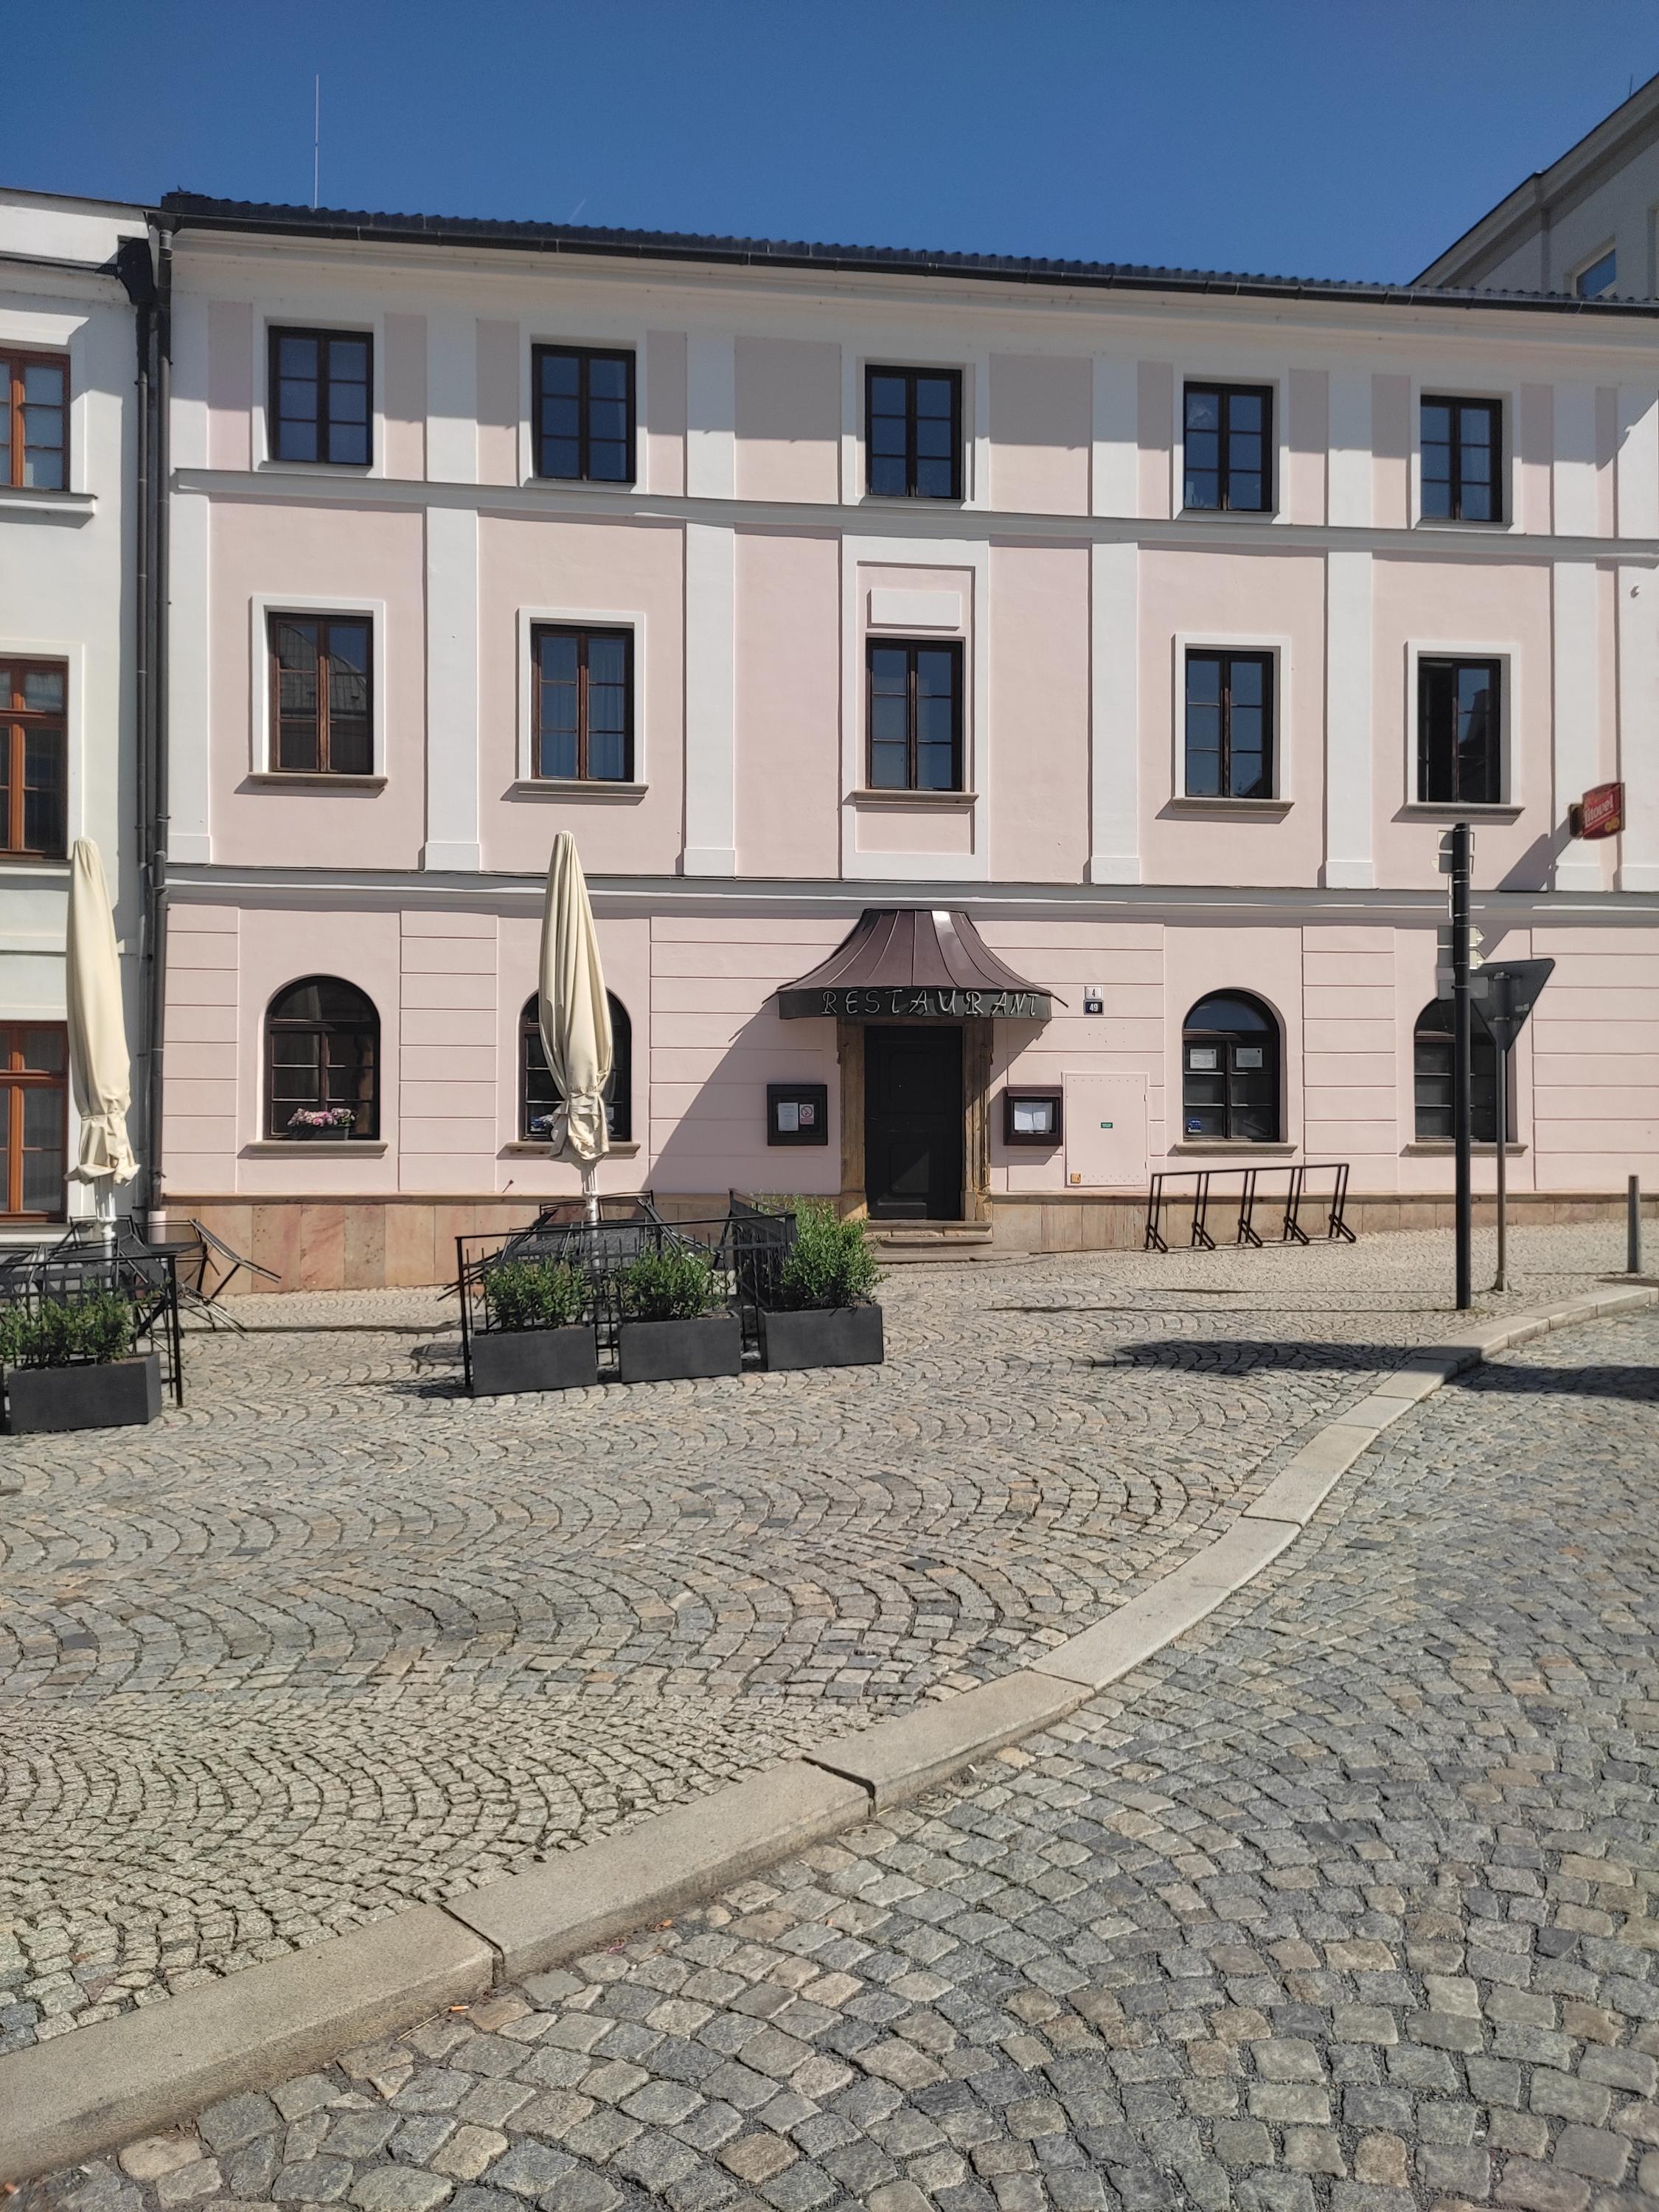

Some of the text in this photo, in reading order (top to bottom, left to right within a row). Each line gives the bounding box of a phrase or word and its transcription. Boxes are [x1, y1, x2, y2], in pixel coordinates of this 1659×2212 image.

[1091, 988, 1096, 998] 4
[821, 990, 1040, 1015] RESTAURANT
[1089, 1003, 1099, 1012] 49
